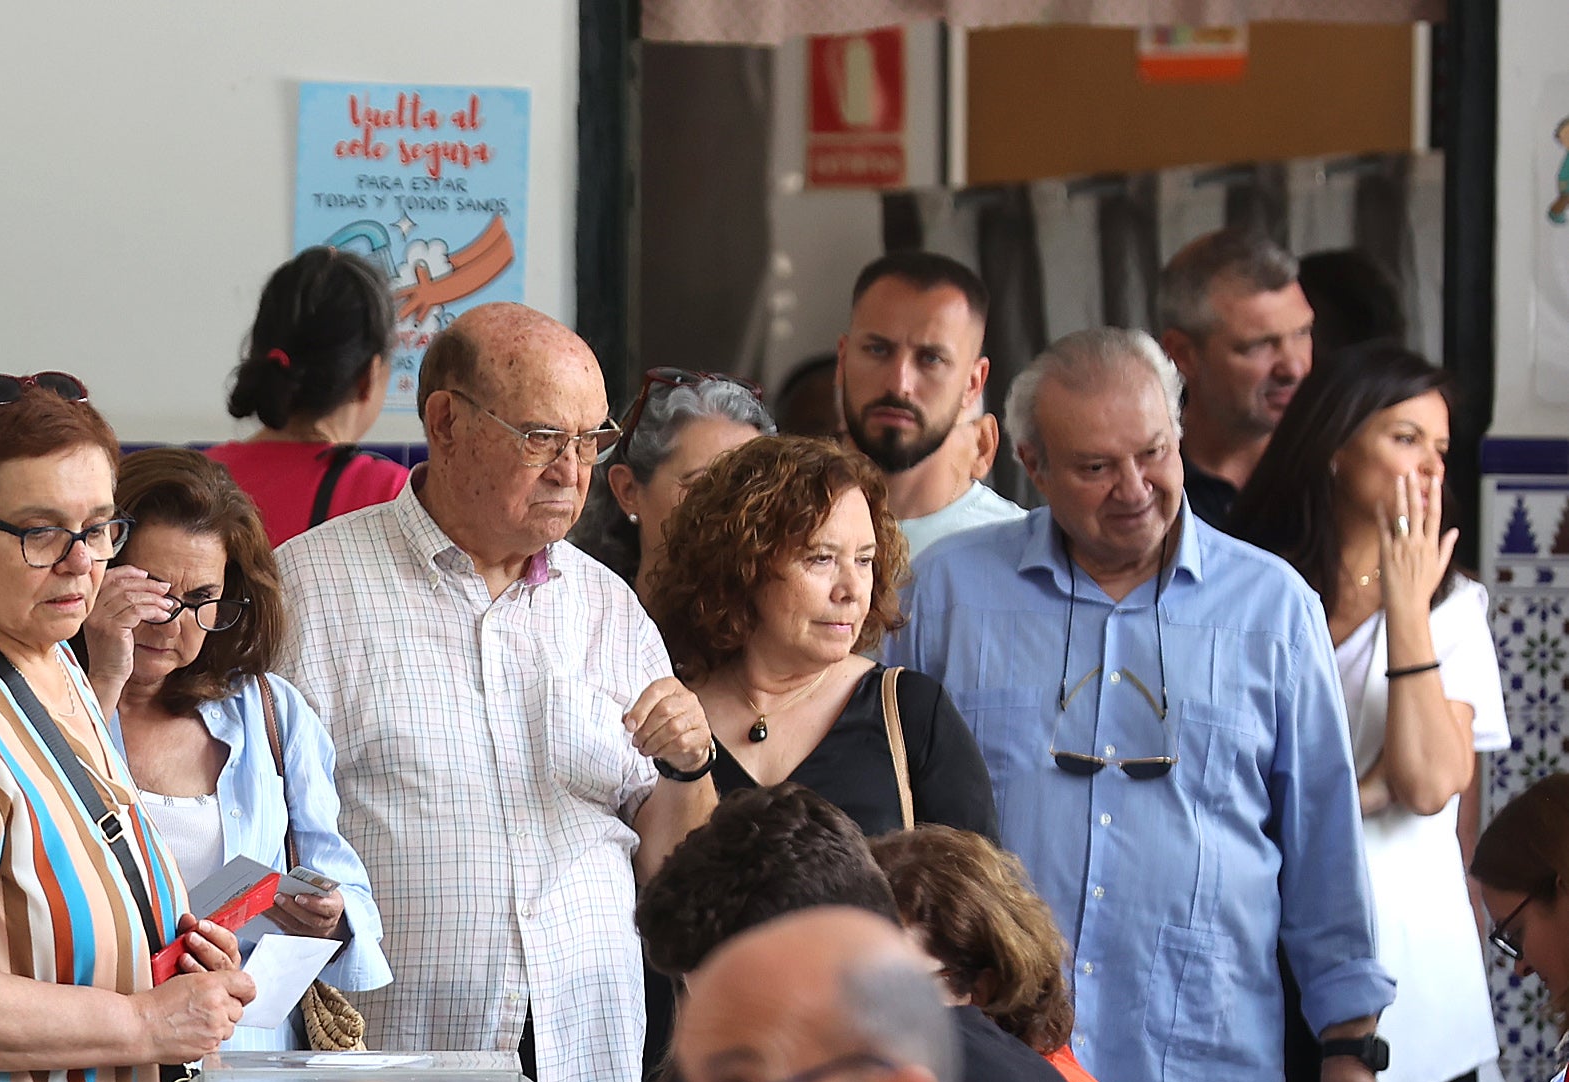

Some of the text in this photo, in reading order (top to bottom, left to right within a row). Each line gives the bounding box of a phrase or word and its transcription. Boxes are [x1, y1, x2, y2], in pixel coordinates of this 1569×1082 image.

[347, 91, 481, 130] Vuelta al
[334, 122, 492, 180] cole segura
[356, 174, 469, 194] PARA ESTAR
[312, 192, 511, 216] TODAS Y TODOS SANOS
